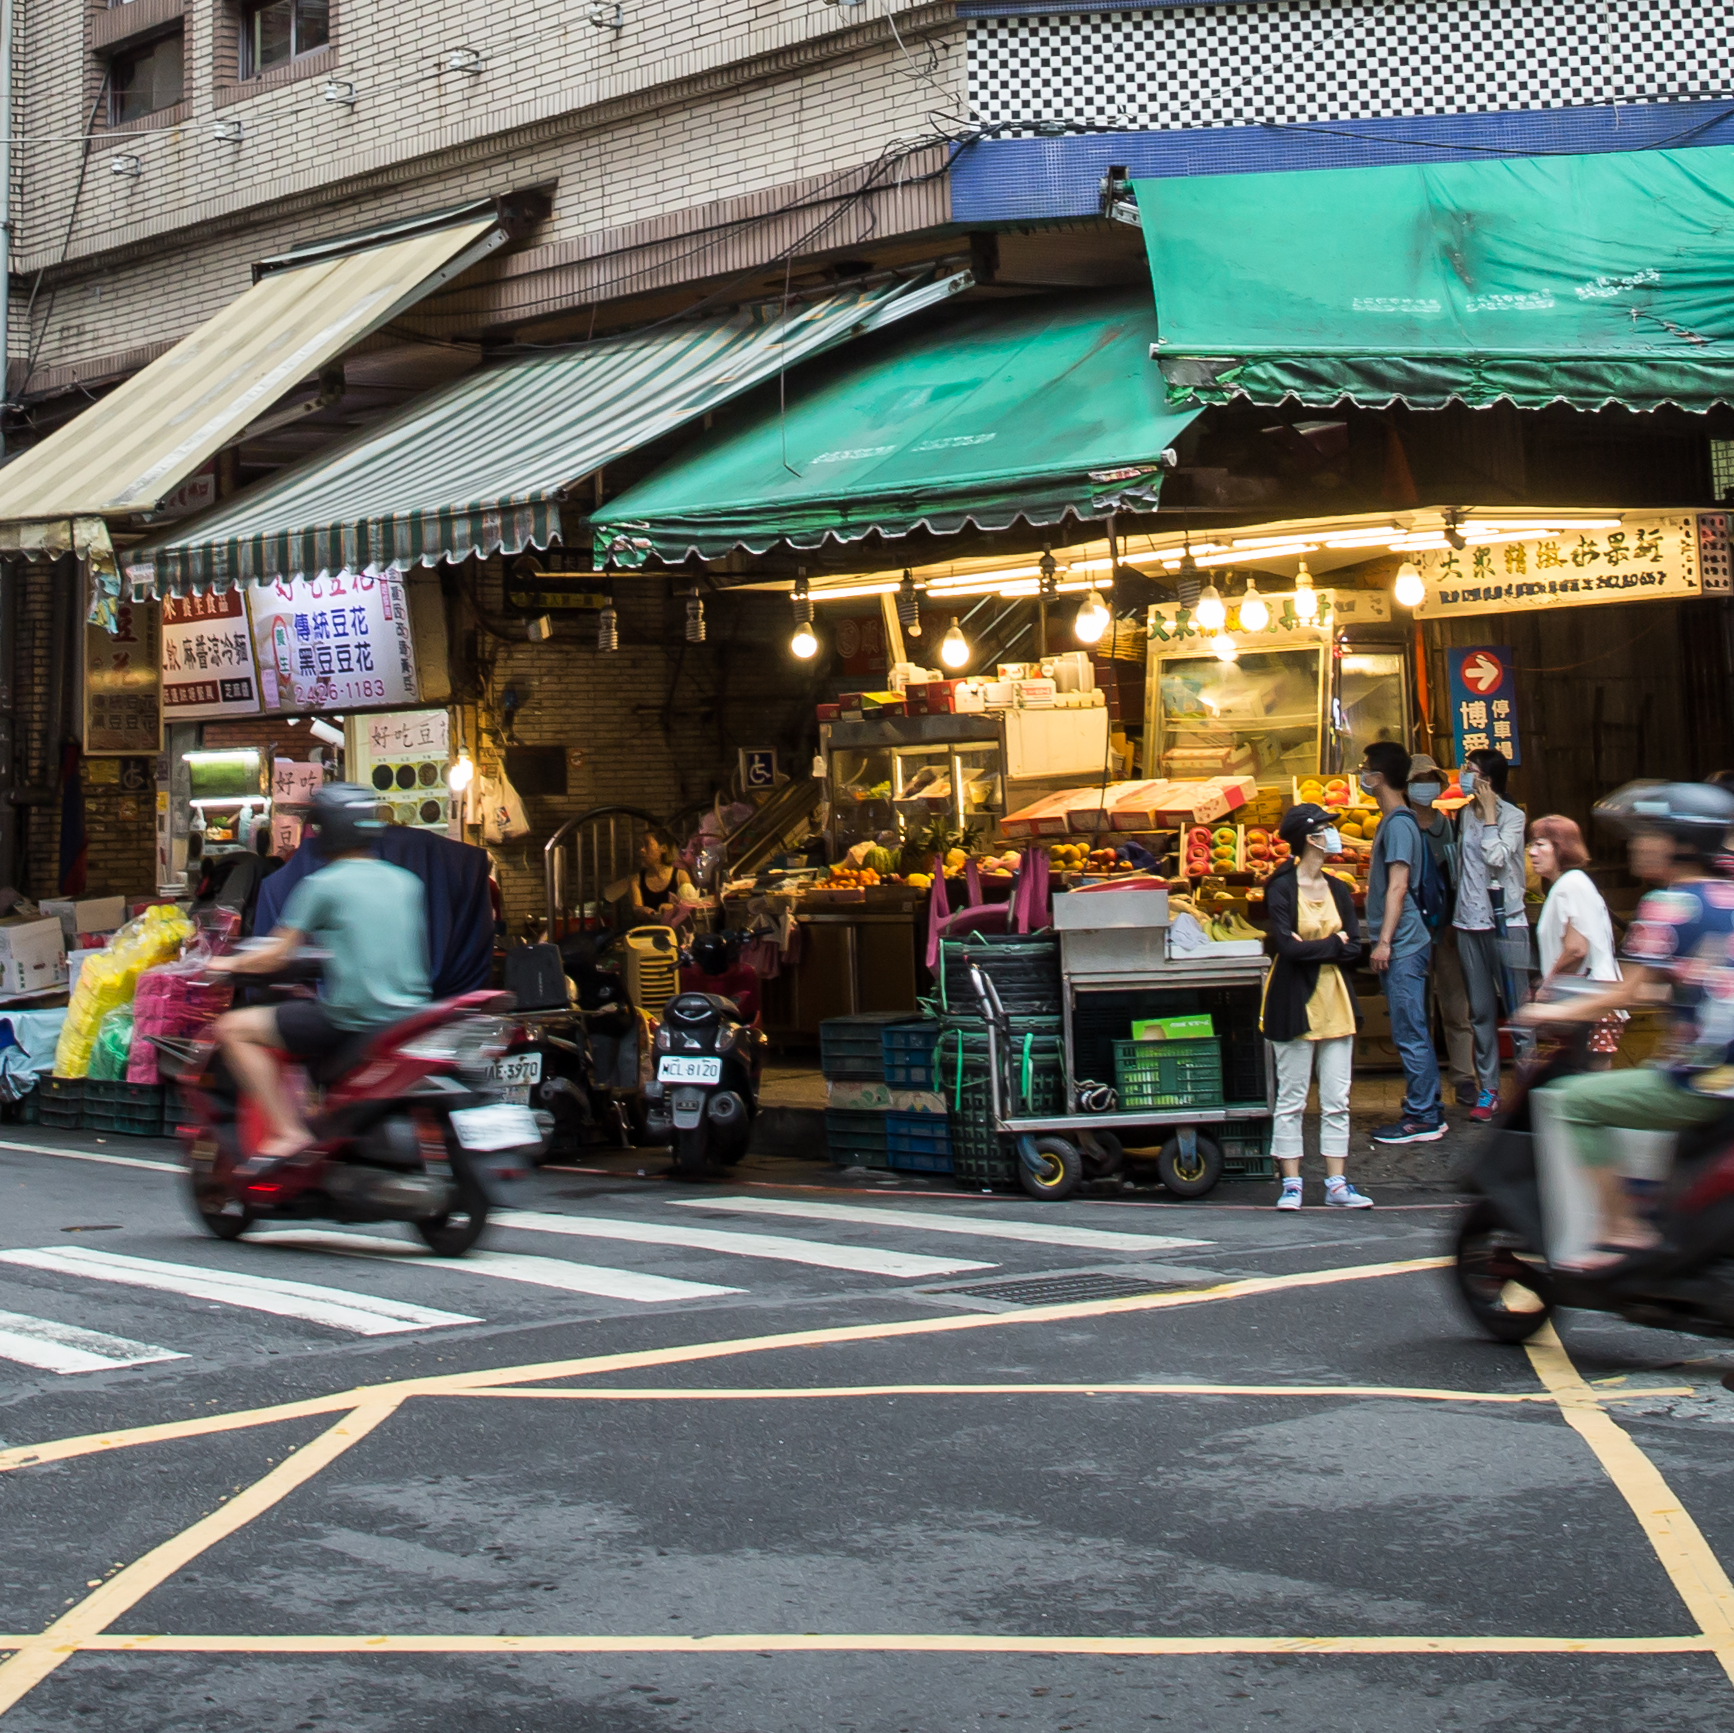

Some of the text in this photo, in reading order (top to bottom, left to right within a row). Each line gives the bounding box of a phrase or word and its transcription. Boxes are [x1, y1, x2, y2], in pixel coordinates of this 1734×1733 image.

[293, 604, 370, 642] 傳統豆花
[298, 641, 375, 677] 黑豆豆花
[1491, 699, 1515, 760] 停車場
